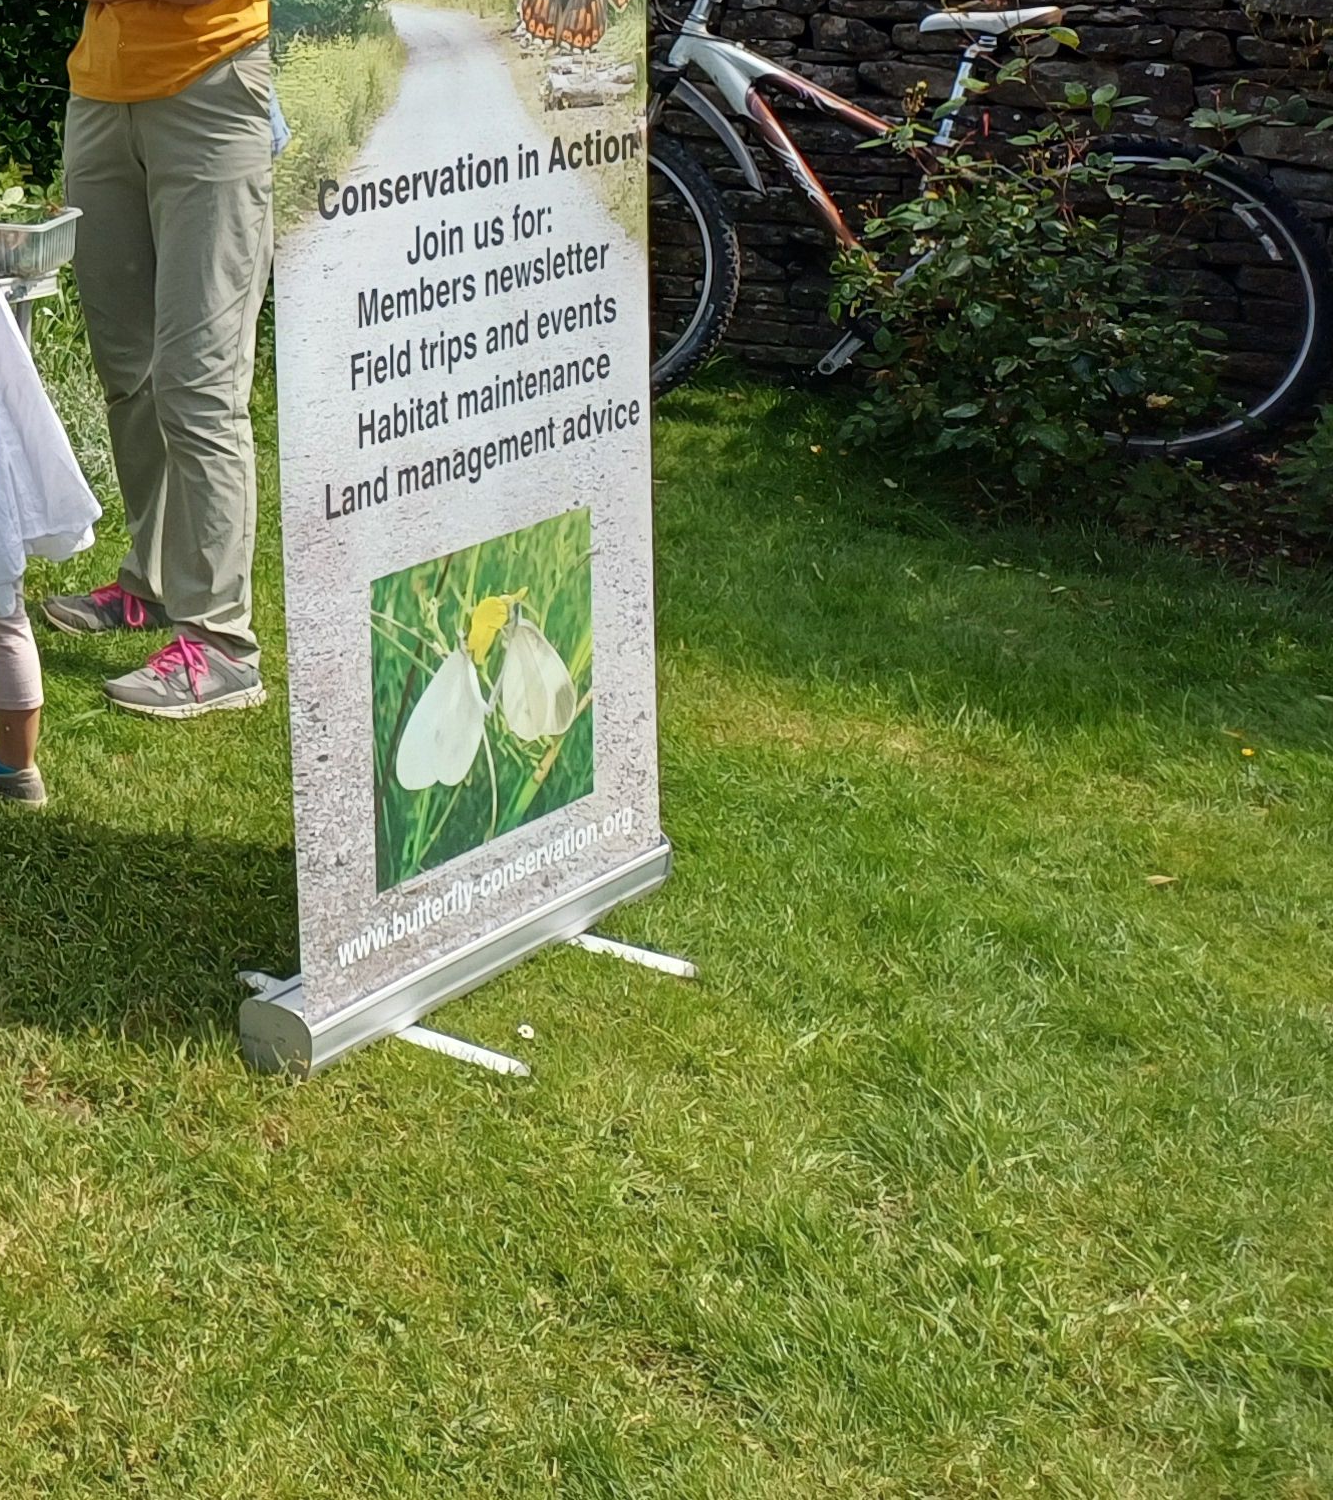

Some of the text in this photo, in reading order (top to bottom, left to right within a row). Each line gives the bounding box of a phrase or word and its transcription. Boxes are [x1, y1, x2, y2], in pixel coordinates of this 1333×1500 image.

[318, 130, 636, 220] Conservation in Action
[407, 204, 553, 265] Join us for:
[358, 241, 609, 328] Members newsletter
[351, 294, 617, 391] Field trips and events
[358, 353, 611, 449] Habitat maintenance
[325, 399, 641, 520] Land management advice
[337, 805, 635, 969] www.butterfly-conservation.org
